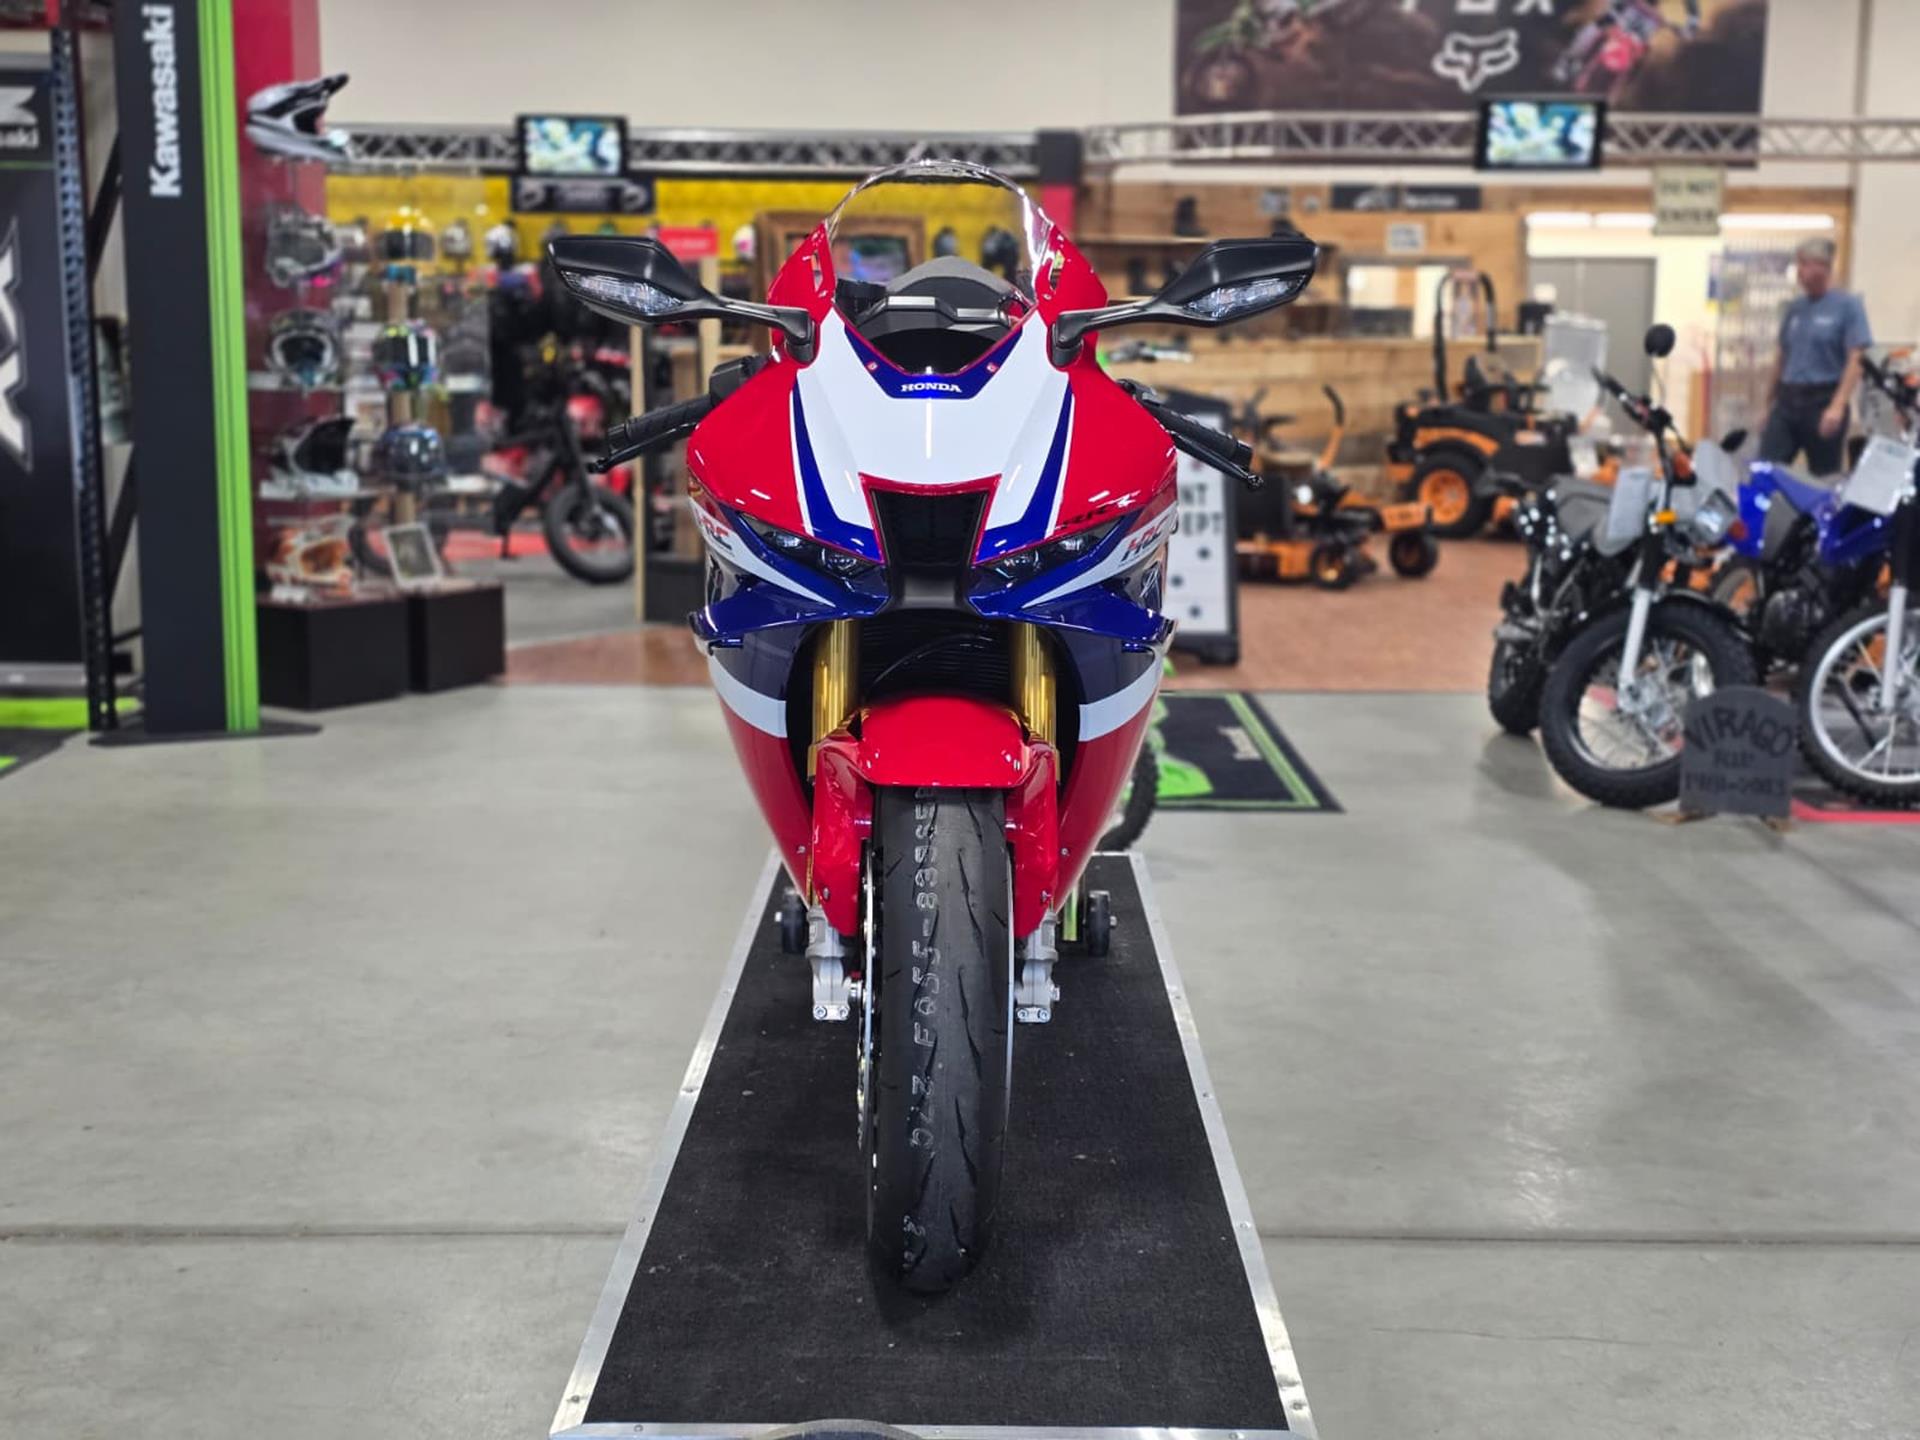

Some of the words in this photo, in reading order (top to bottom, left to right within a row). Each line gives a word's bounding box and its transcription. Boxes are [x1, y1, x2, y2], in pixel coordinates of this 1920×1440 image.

[141, 4, 181, 197] Kawasaki
[900, 382, 963, 393] HONDA
[1683, 706, 1793, 759] VIRAGO
